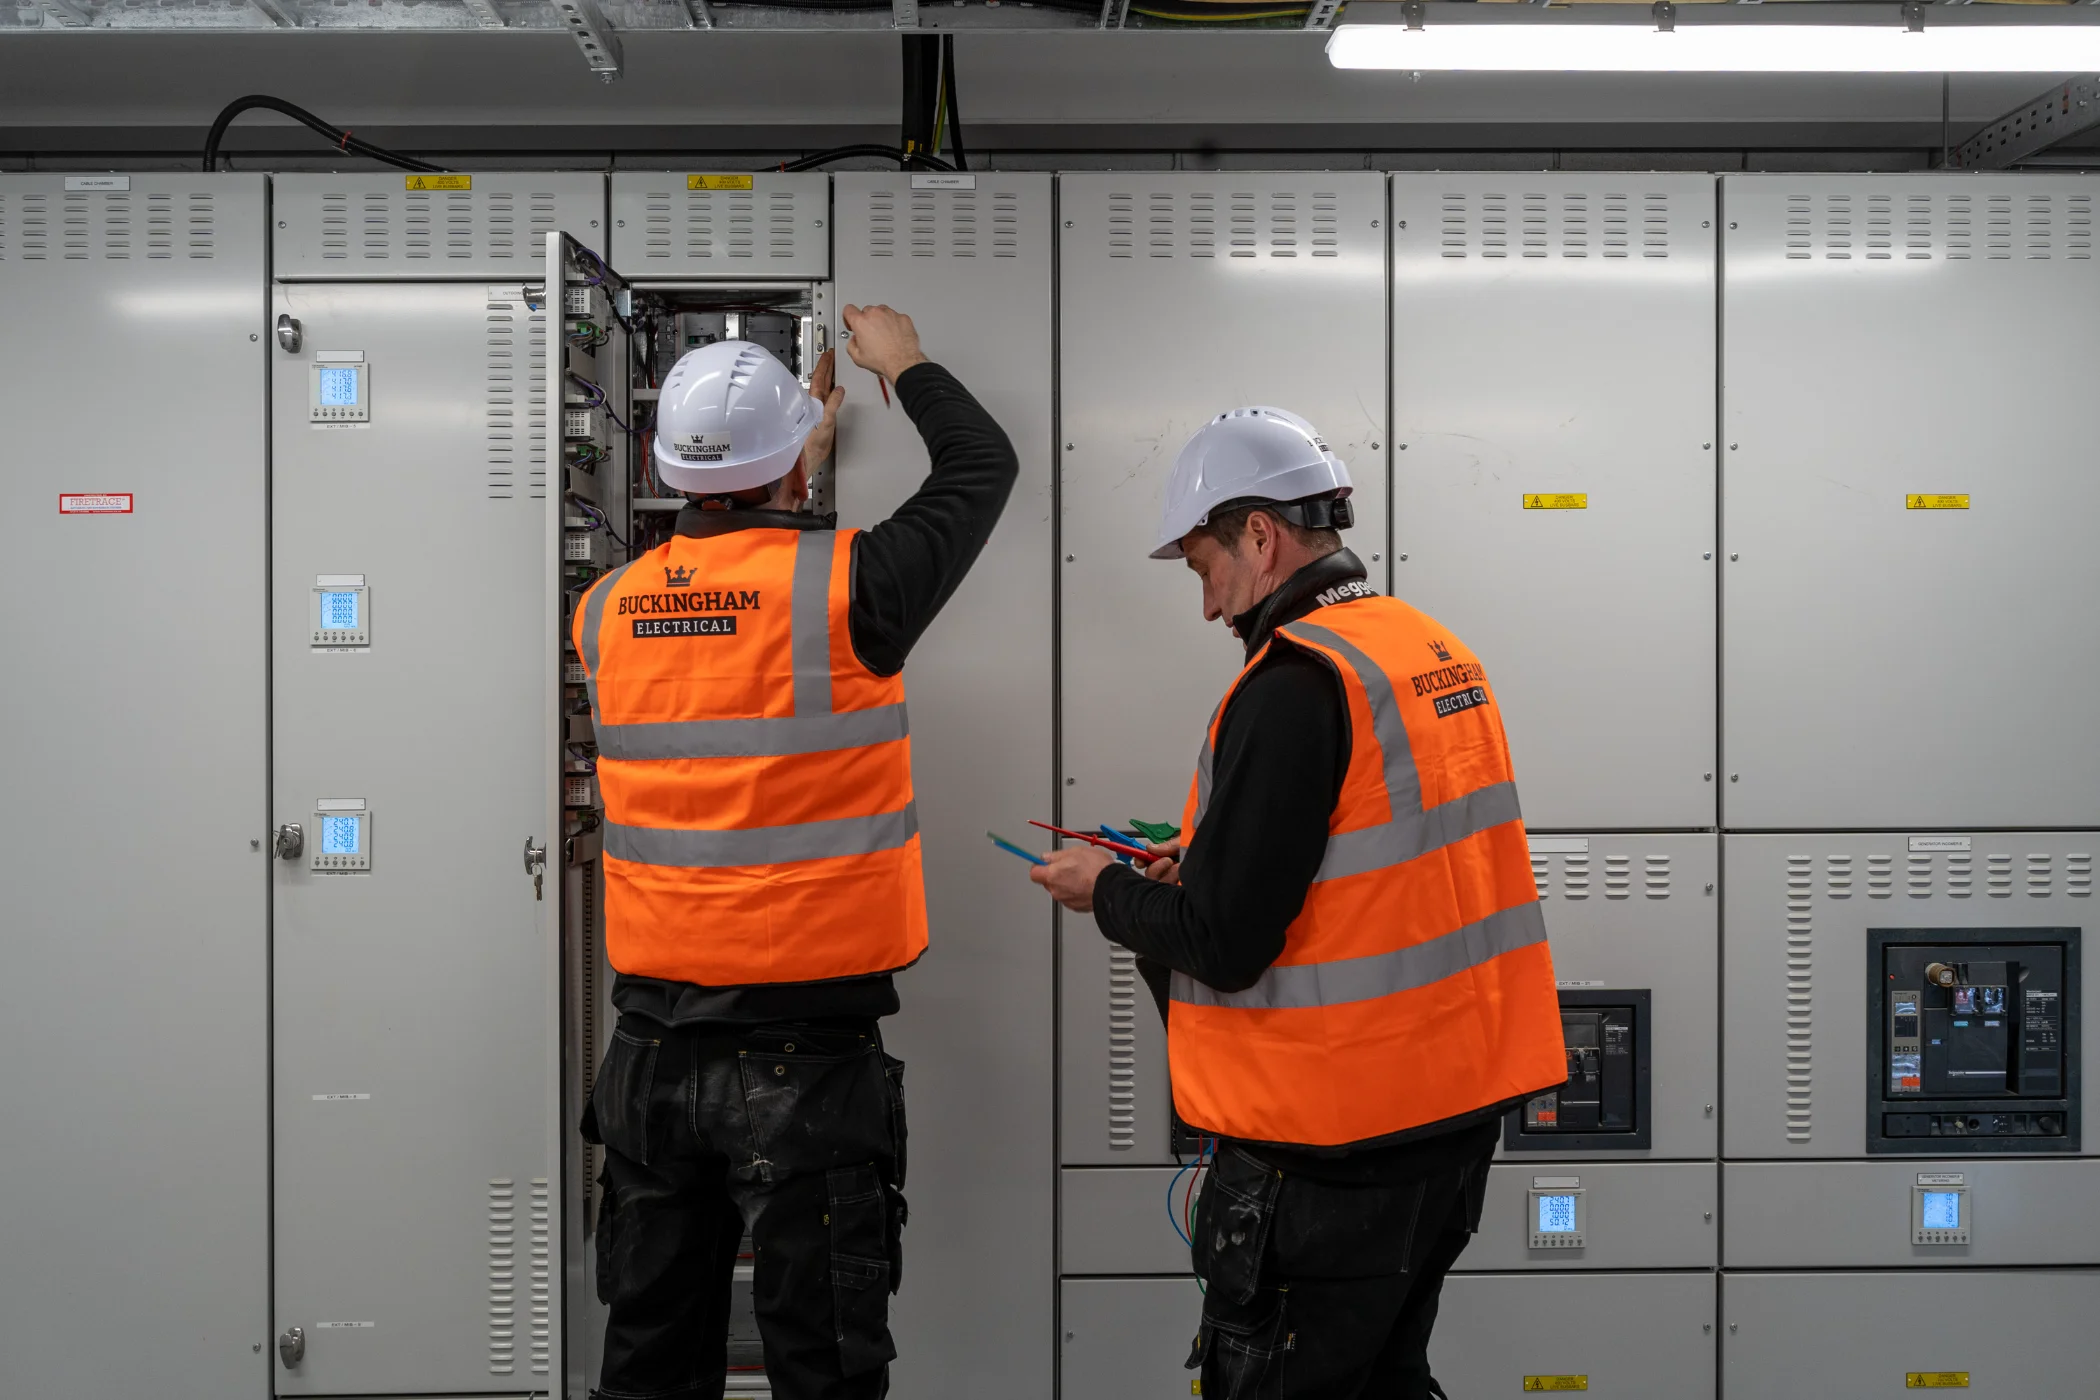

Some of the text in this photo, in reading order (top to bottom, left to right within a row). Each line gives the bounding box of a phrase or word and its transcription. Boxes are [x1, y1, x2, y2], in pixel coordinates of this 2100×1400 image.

[674, 443, 730, 453] BUCKINGHAM
[618, 591, 760, 615] BUCKINGHAM
[636, 619, 731, 635] ELECTRICAL
